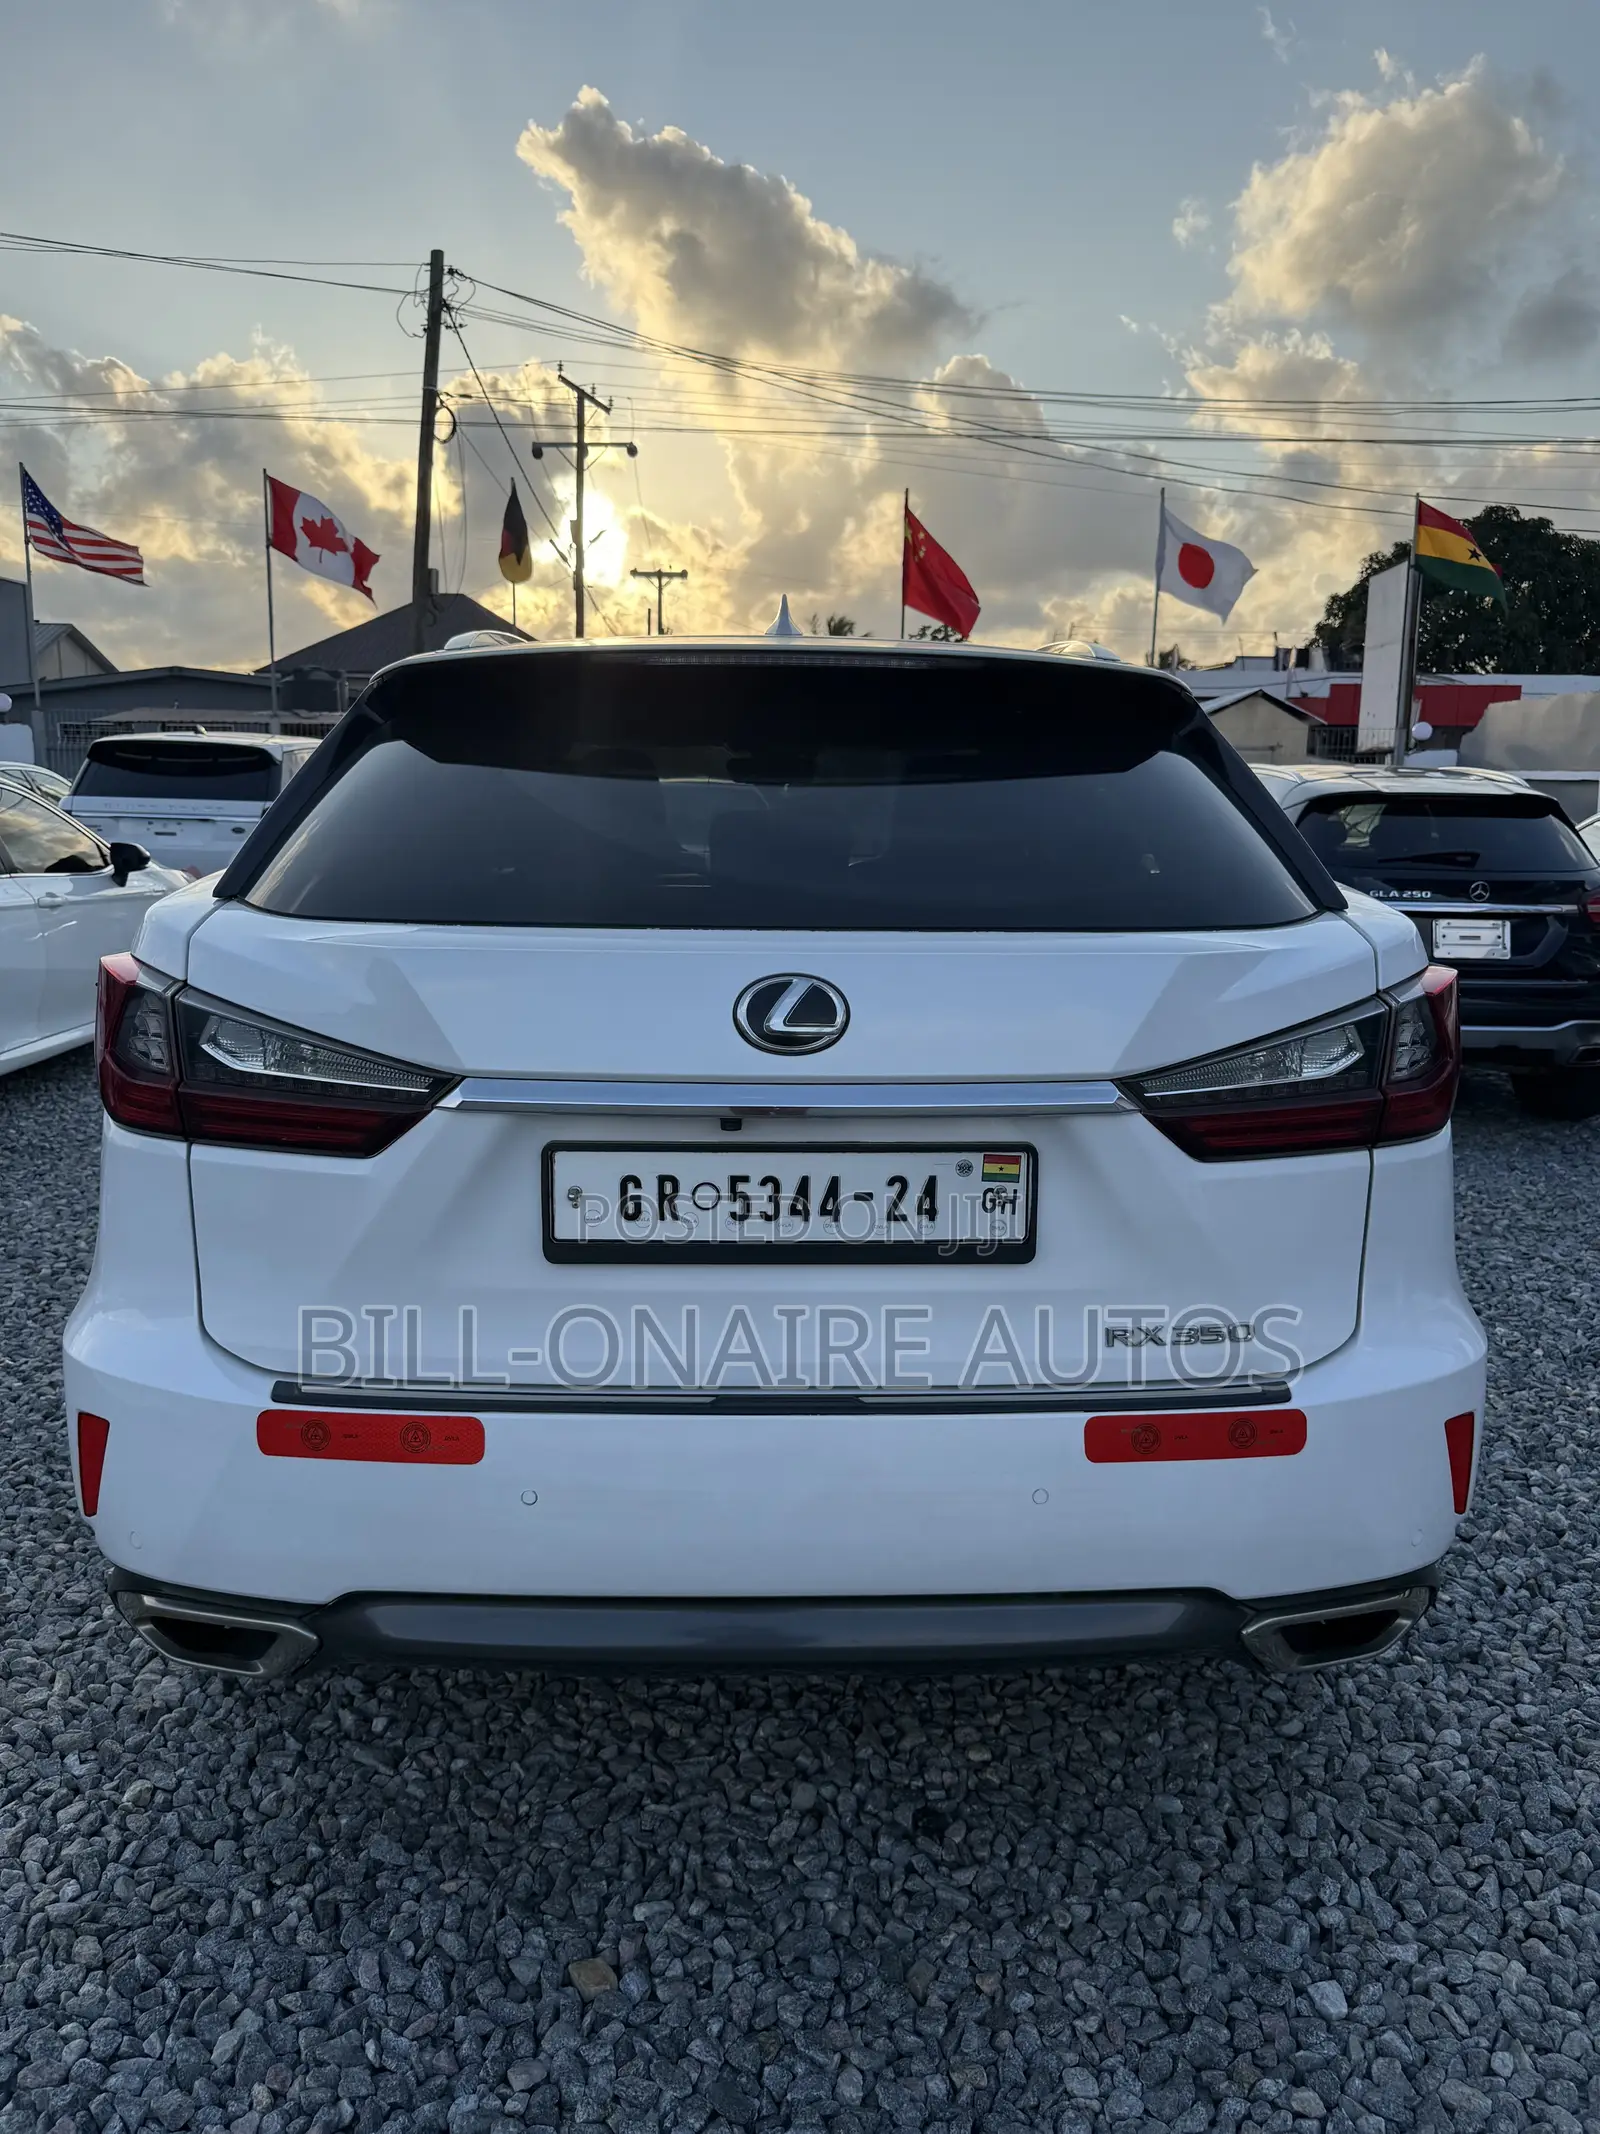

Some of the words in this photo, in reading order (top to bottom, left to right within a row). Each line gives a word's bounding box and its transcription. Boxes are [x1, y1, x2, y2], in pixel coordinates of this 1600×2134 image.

[1369, 889, 1399, 898] GLA
[1402, 890, 1431, 898] 250
[619, 1174, 681, 1222] GR
